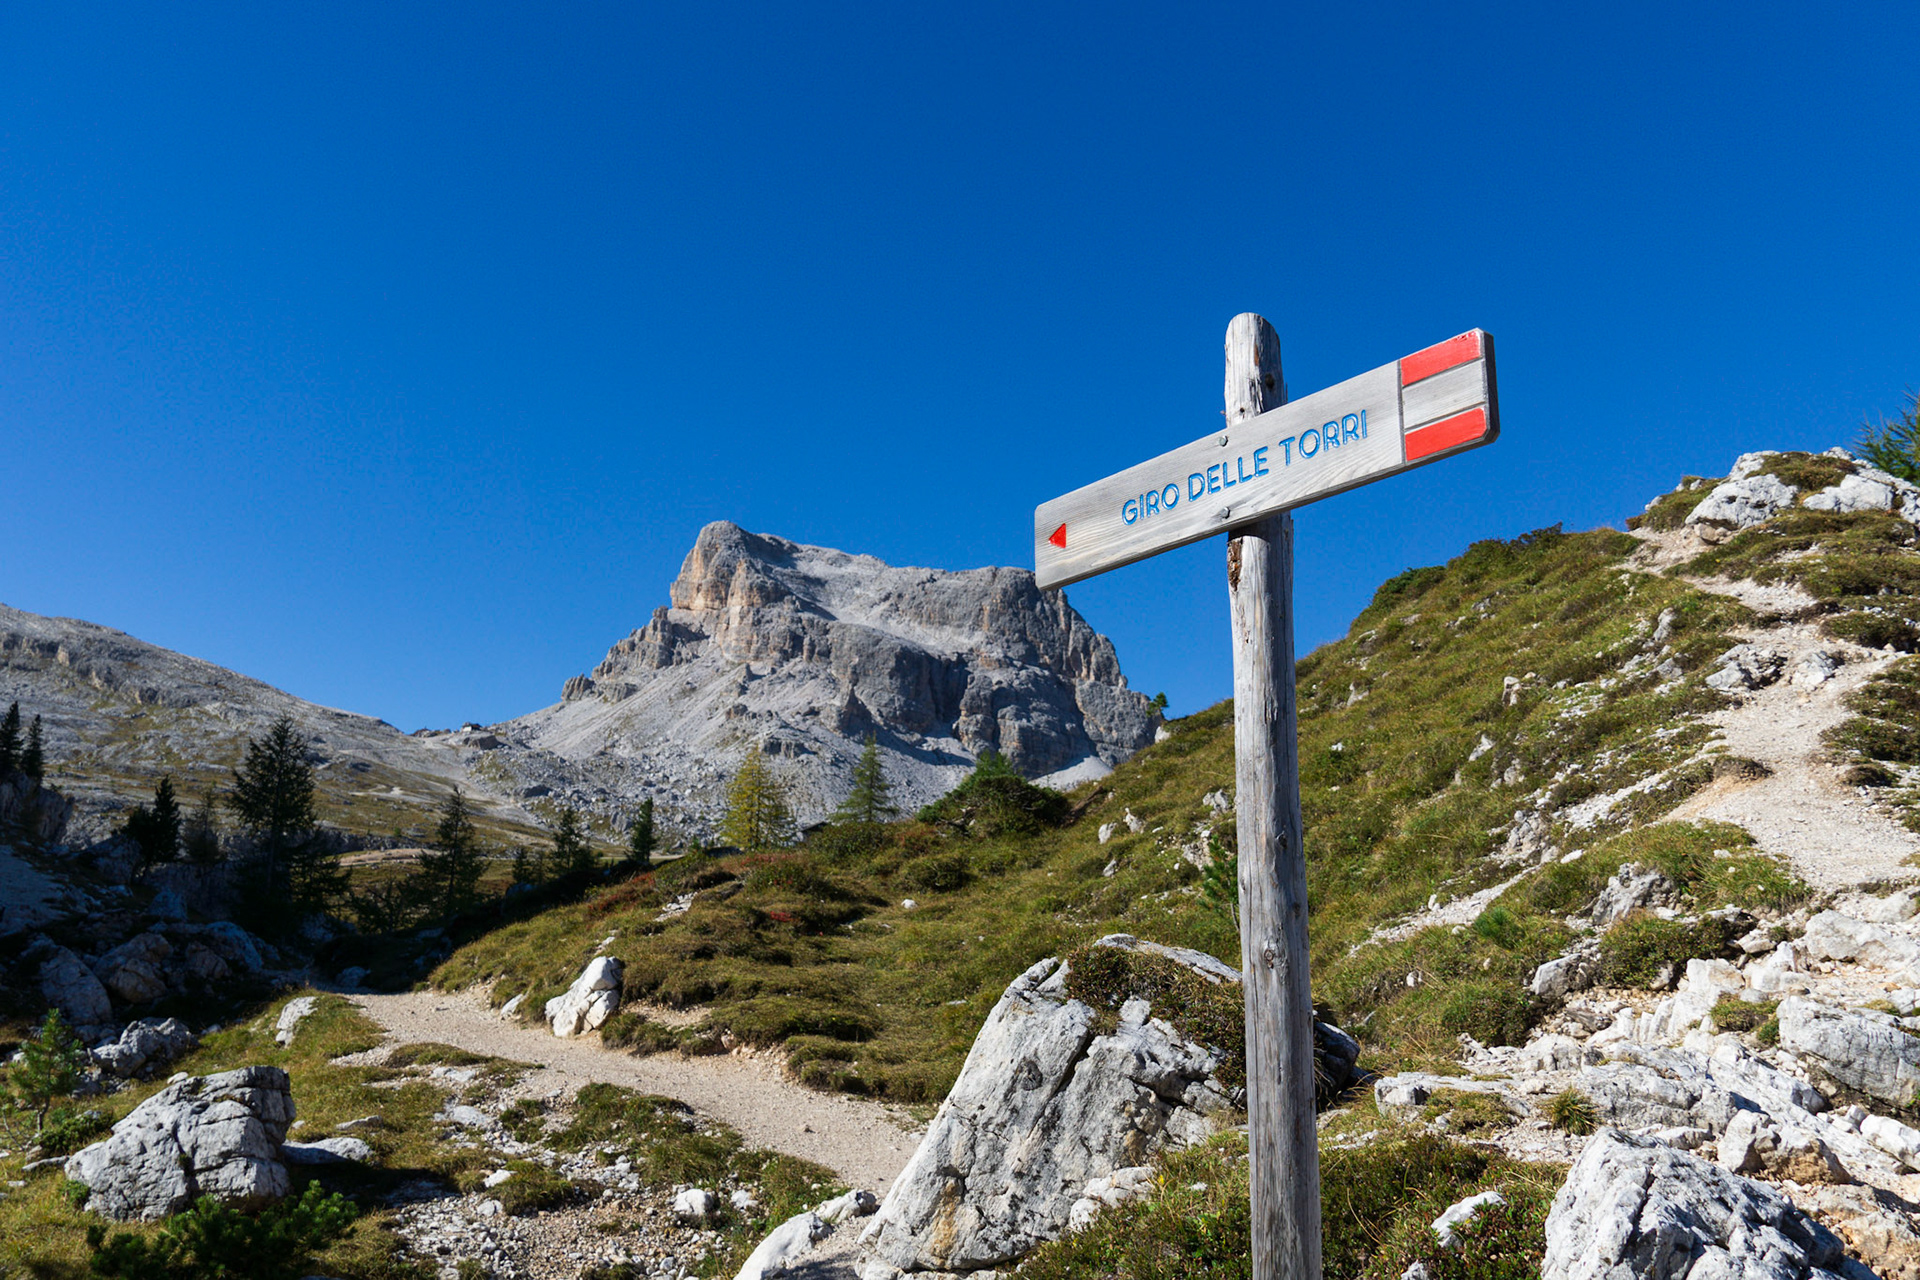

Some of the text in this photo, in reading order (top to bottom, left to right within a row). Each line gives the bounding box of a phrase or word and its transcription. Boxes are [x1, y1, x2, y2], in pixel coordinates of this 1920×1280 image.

[1122, 409, 1368, 526] GIRO DELLE TORRI
